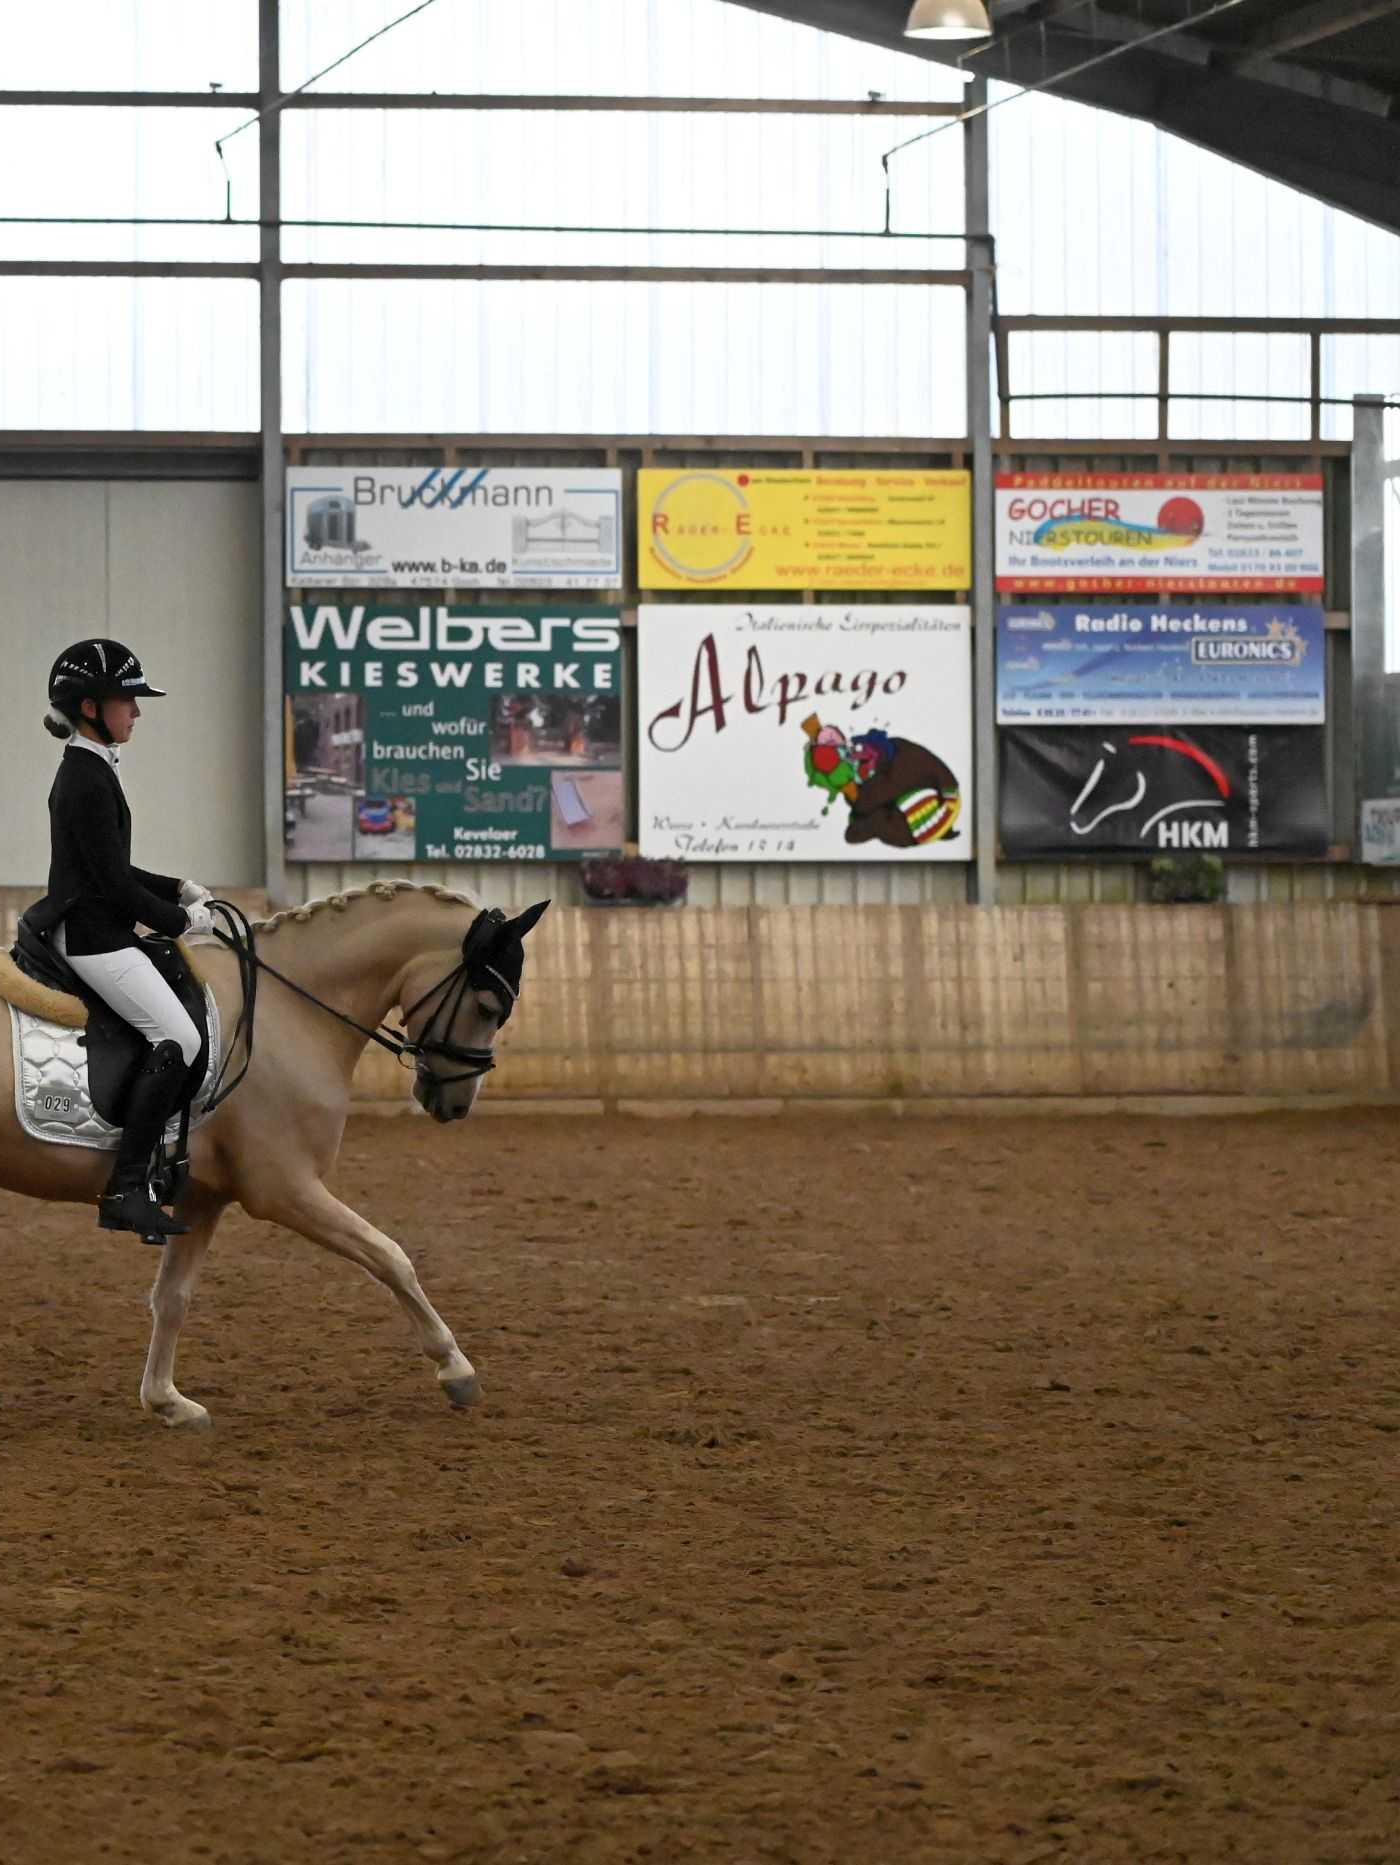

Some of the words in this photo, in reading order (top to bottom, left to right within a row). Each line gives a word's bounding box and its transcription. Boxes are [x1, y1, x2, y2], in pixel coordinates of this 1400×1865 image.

[354, 476, 553, 507] Bruckmann
[1008, 498, 1121, 521] GOCHER
[290, 605, 621, 652] Welbers
[1075, 613, 1143, 632] Radio
[1151, 613, 1247, 632] Heckens
[1198, 641, 1293, 659] EURONICS
[300, 662, 613, 688] KIESWERKE
[648, 633, 908, 752] Alpago
[402, 701, 434, 717] und
[432, 716, 486, 736] wofür
[373, 741, 465, 760] brauchen
[466, 758, 501, 781] Sie
[372, 767, 432, 795] Kies
[454, 826, 517, 842] Kevelaer
[1158, 821, 1228, 848] HKM
[426, 845, 450, 858] Tel.
[45, 1096, 70, 1112] 029
